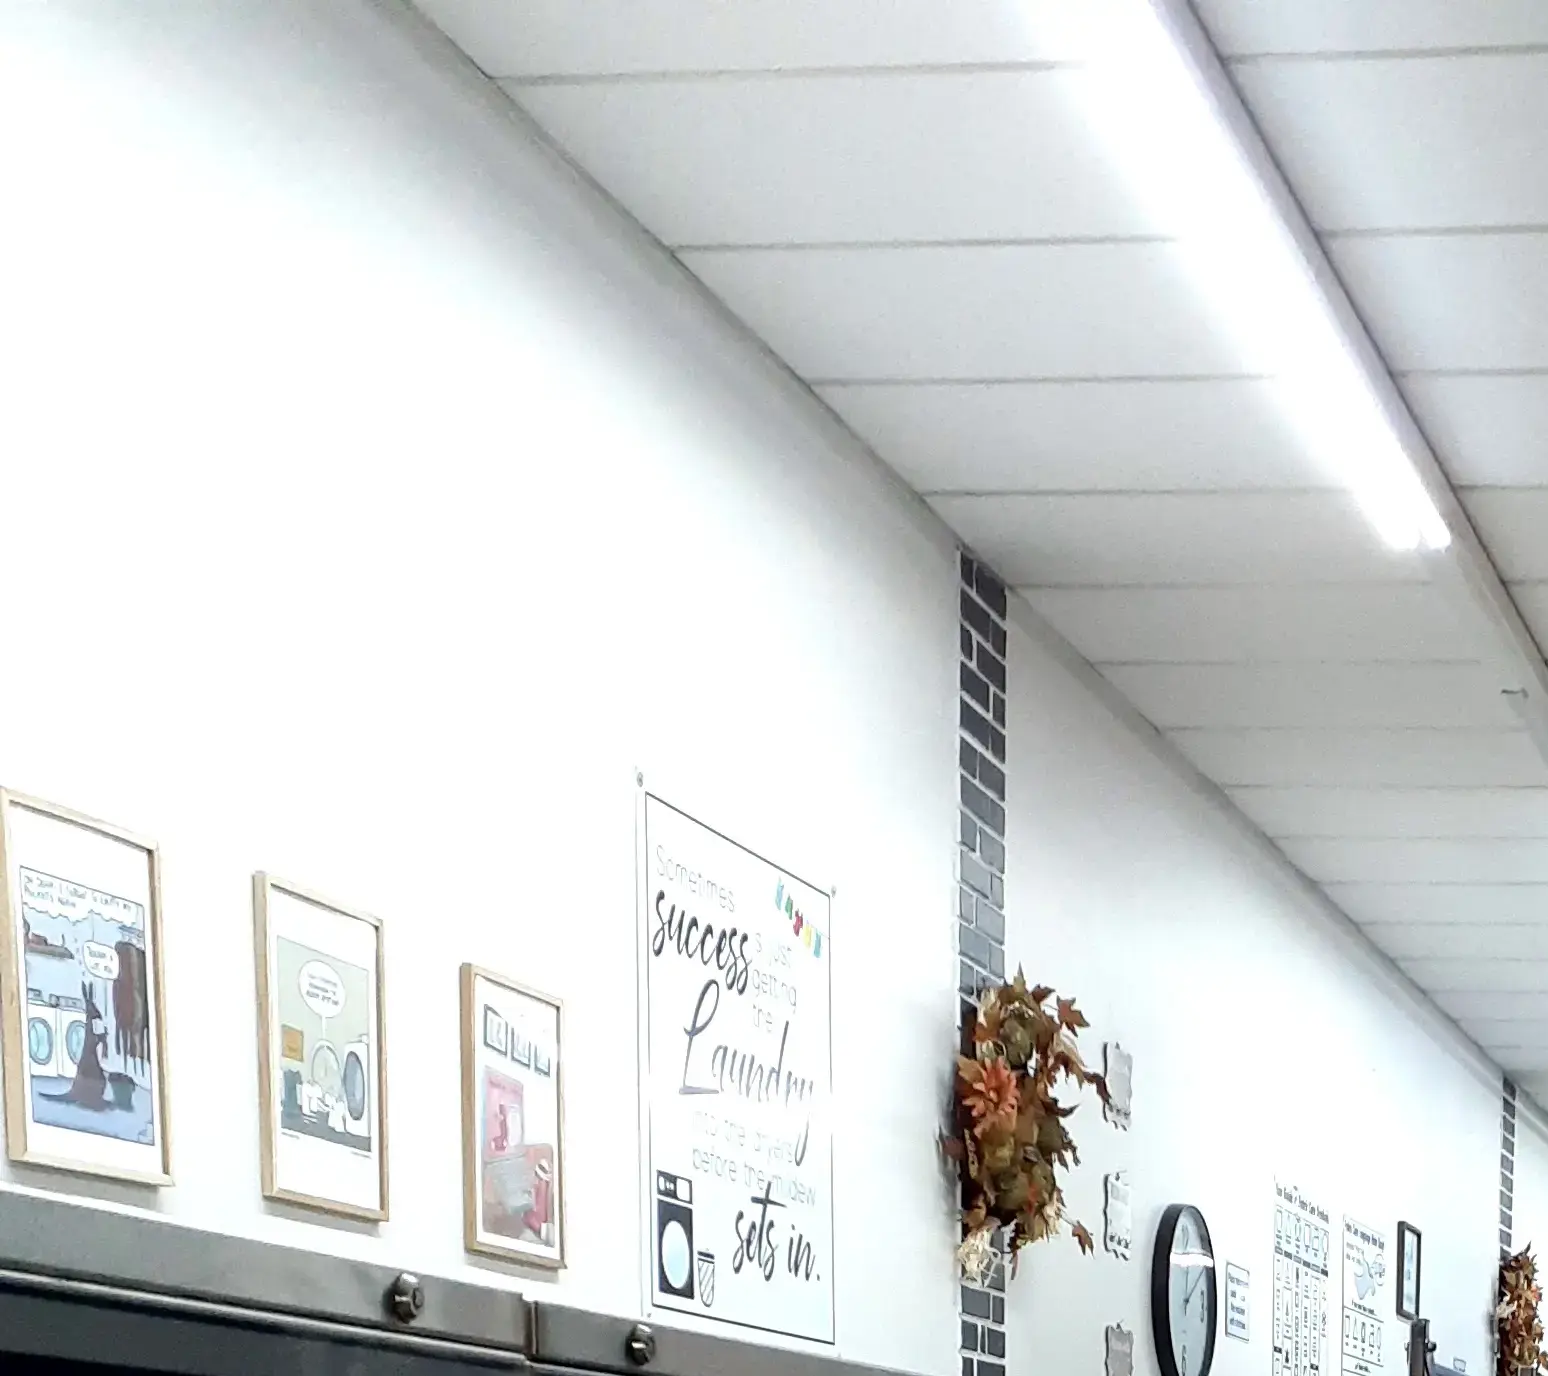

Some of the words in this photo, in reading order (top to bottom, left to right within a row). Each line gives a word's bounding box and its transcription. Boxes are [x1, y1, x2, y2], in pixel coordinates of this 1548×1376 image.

[656, 844, 735, 913] Sometimes
[652, 889, 752, 996] success
[679, 979, 814, 1166] Laundry
[732, 1180, 789, 1282] sets
[787, 1223, 821, 1282] in.
